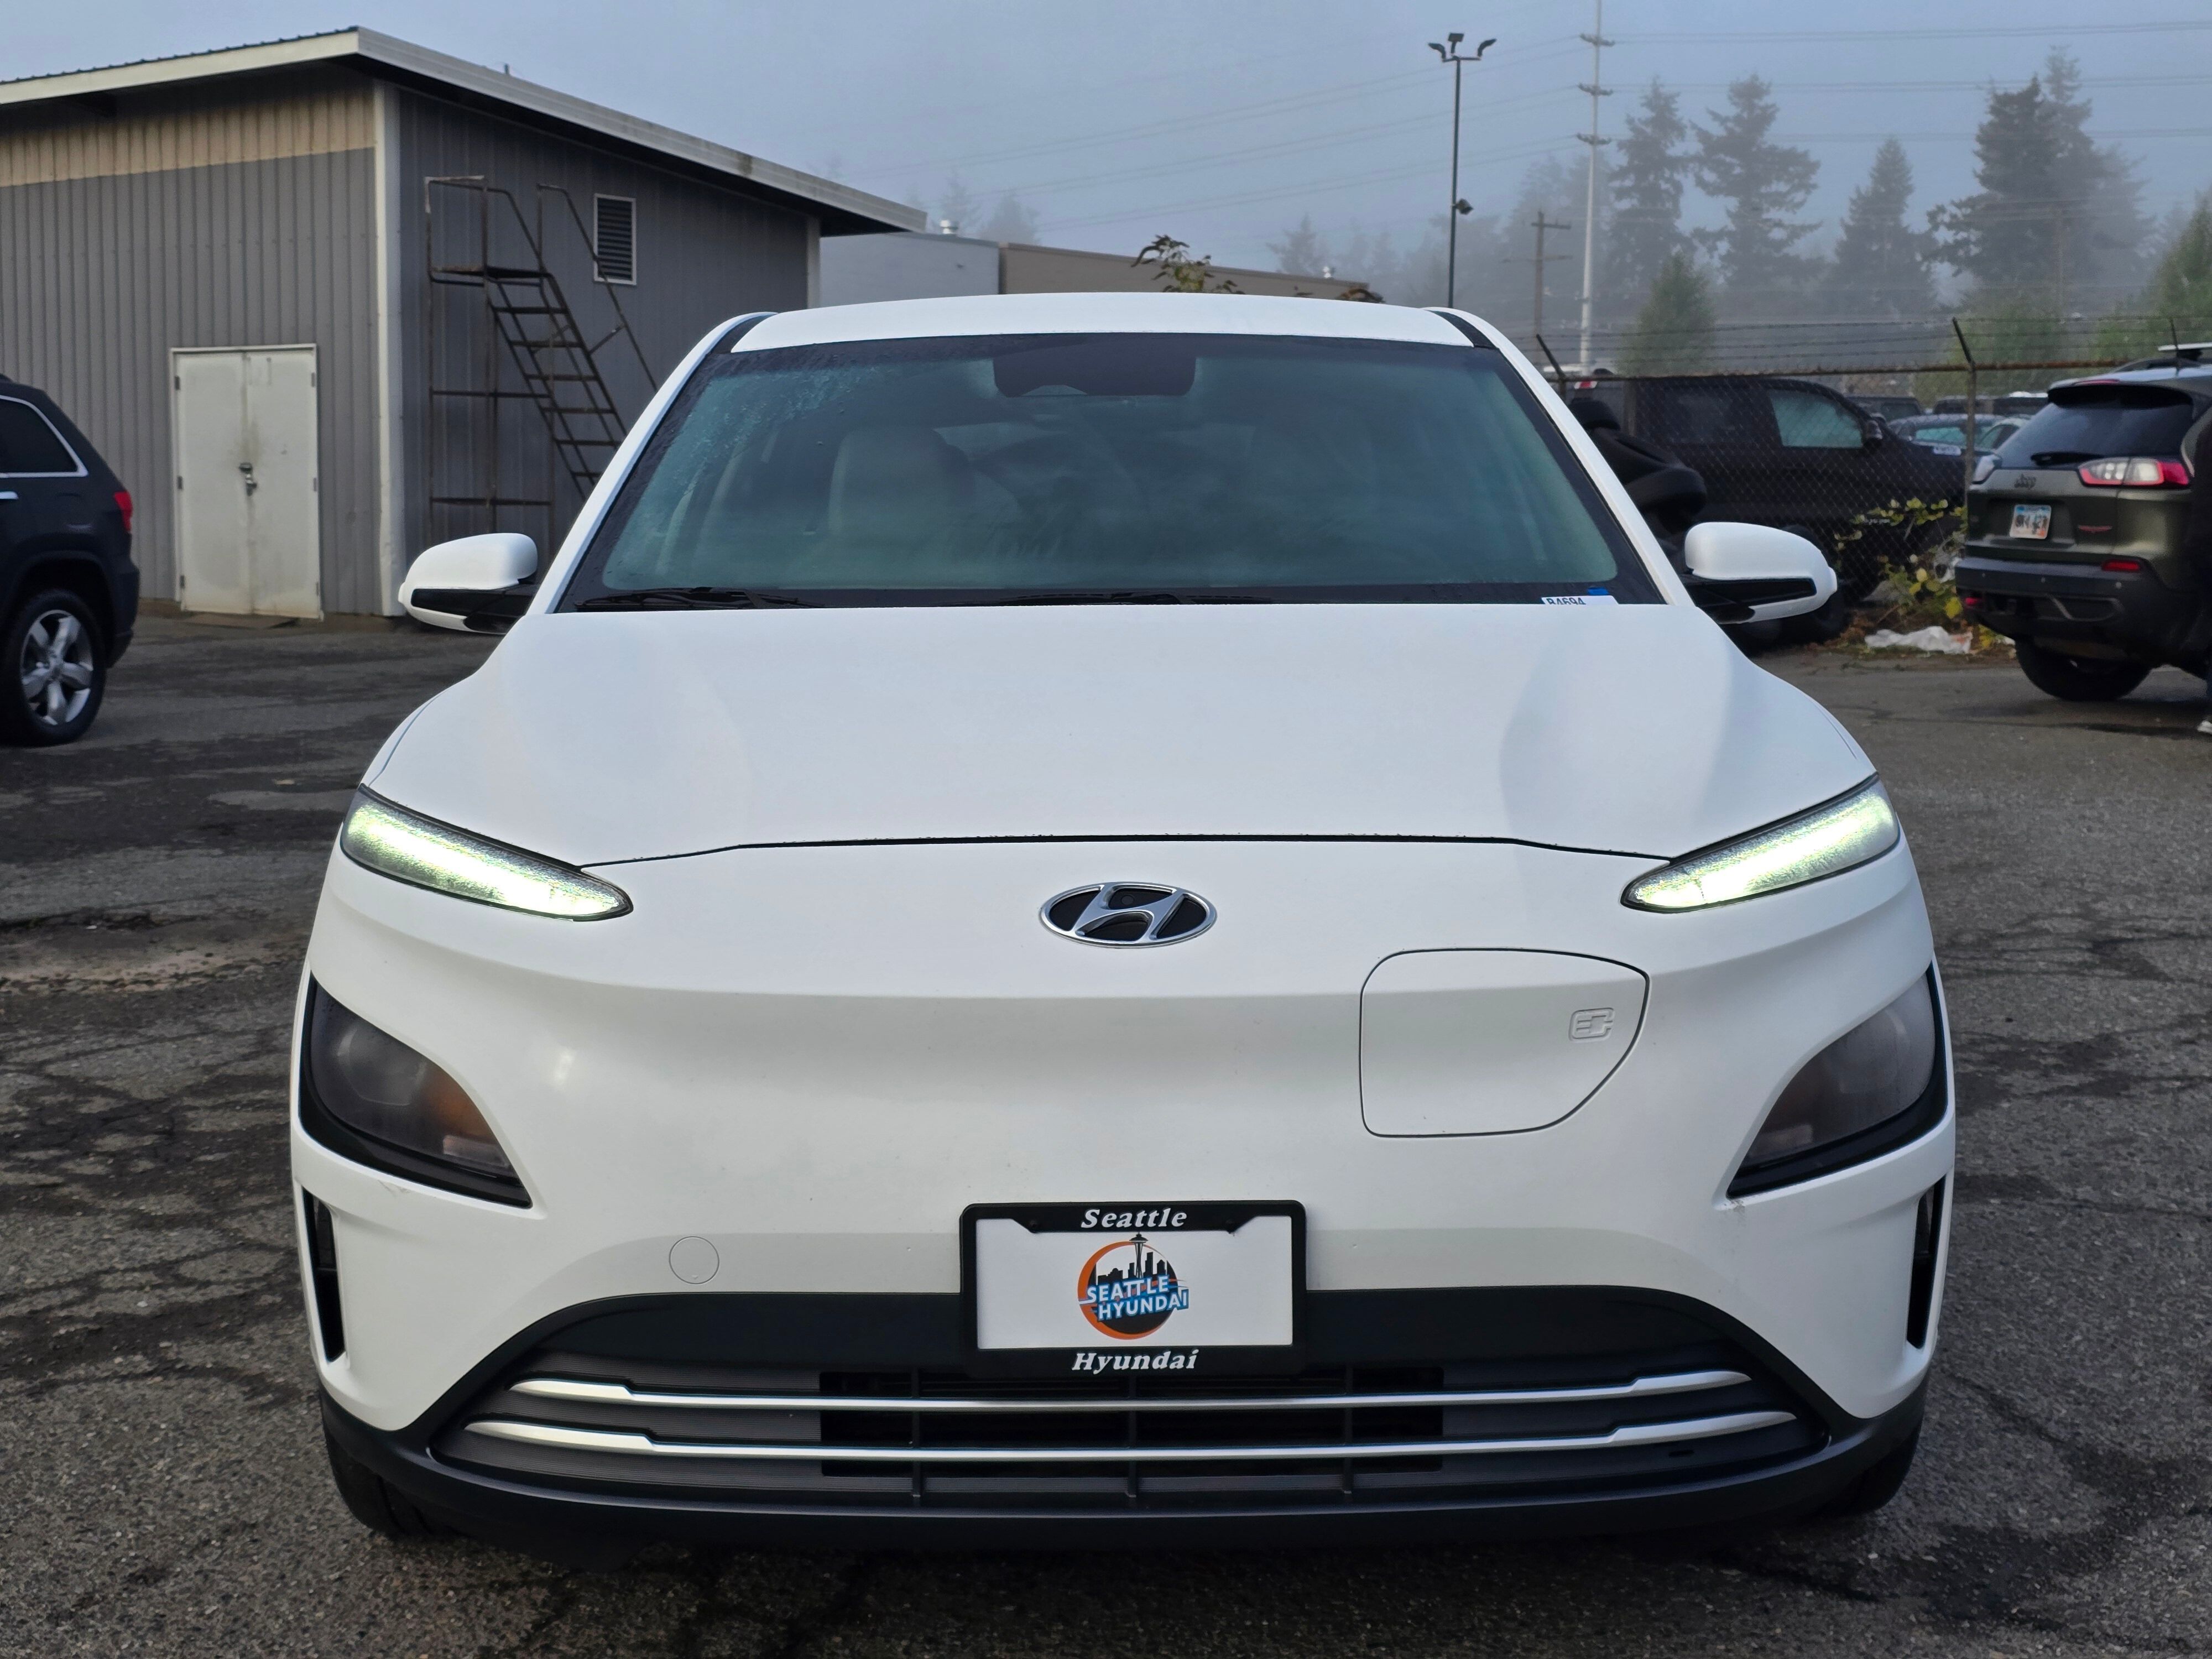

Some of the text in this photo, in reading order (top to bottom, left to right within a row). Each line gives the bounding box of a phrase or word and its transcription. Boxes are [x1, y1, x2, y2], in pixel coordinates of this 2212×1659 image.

[1081, 1208, 1187, 1228] Seattle
[1080, 1275, 1169, 1304] SEATTLE
[1098, 1292, 1187, 1320] HYUNDAI
[1072, 1349, 1199, 1375] Hyundai
